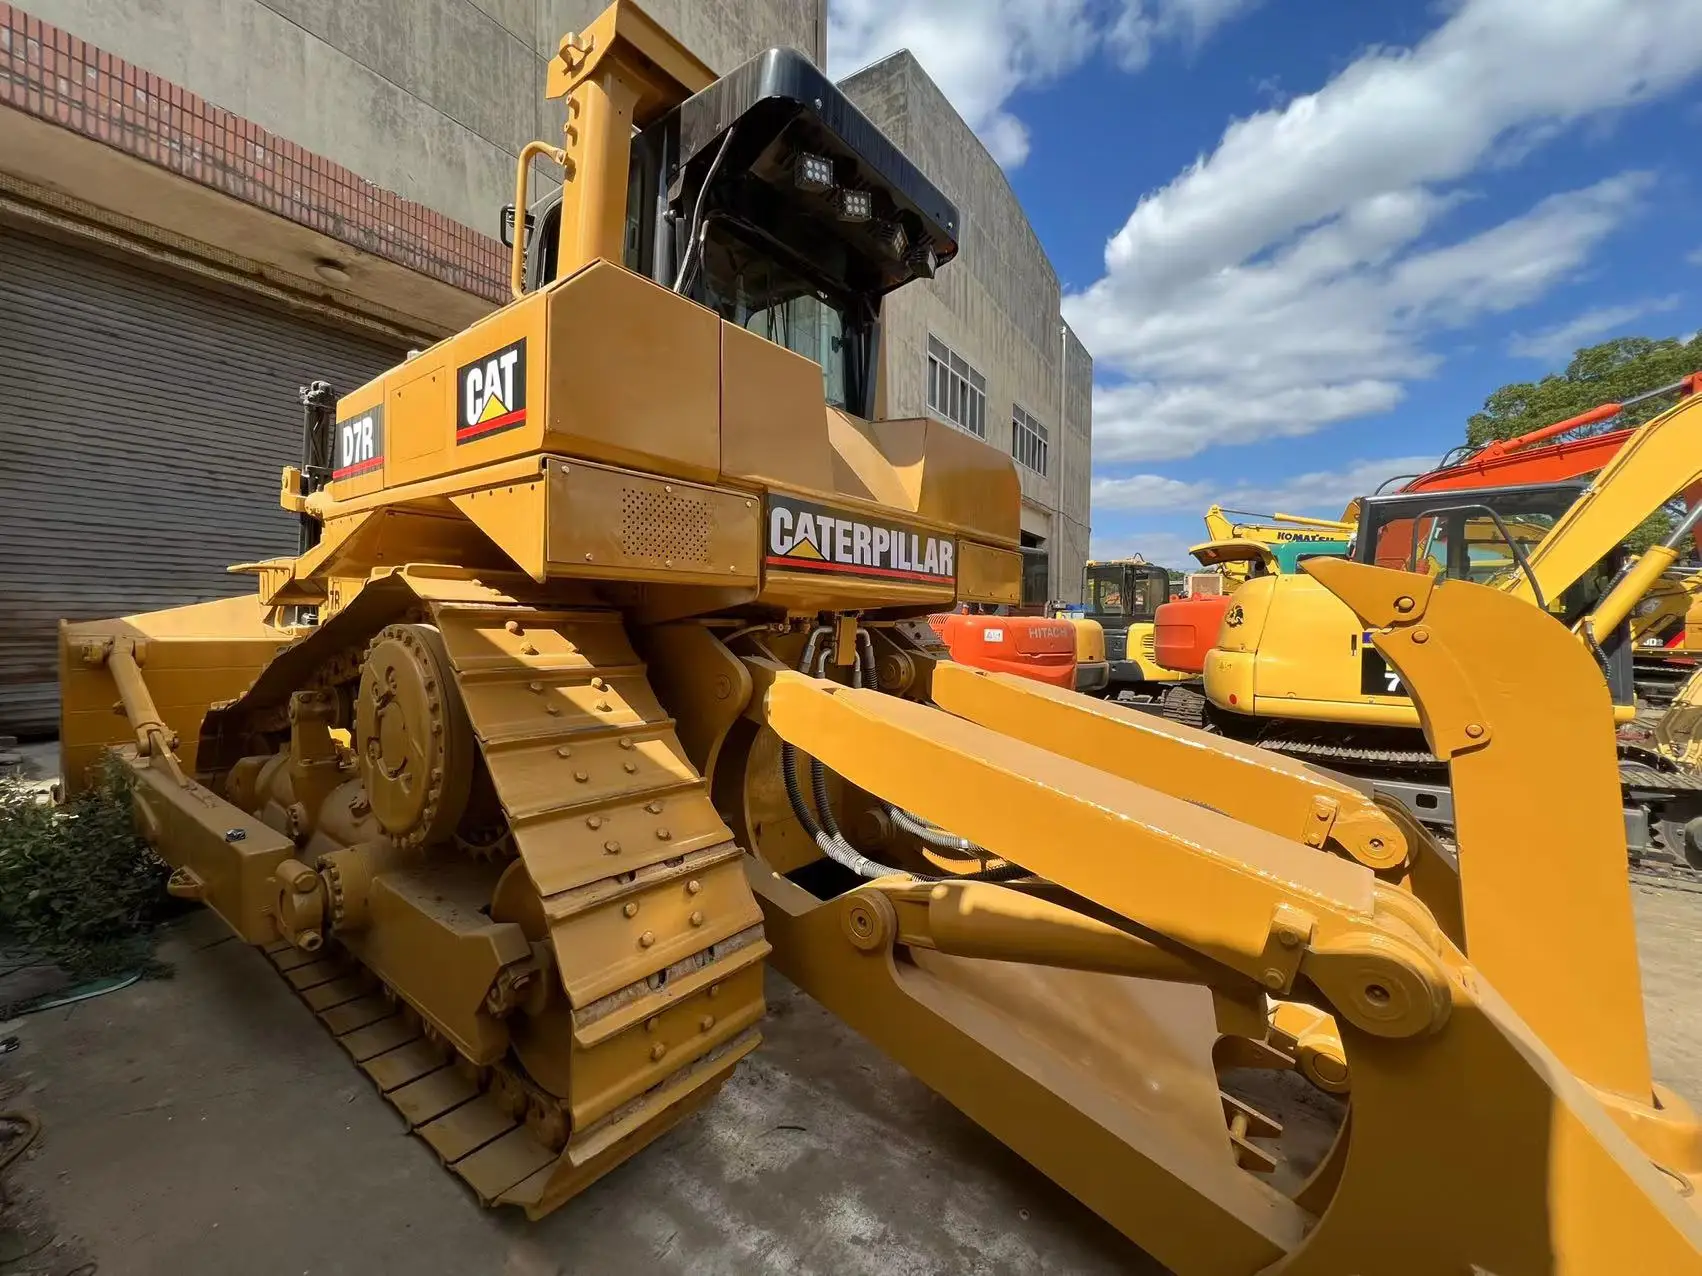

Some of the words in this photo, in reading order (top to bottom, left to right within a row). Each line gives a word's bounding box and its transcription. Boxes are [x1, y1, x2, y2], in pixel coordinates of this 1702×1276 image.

[466, 350, 517, 425] CAT
[342, 416, 373, 467] D7R
[770, 506, 953, 576] CATERPILLAR
